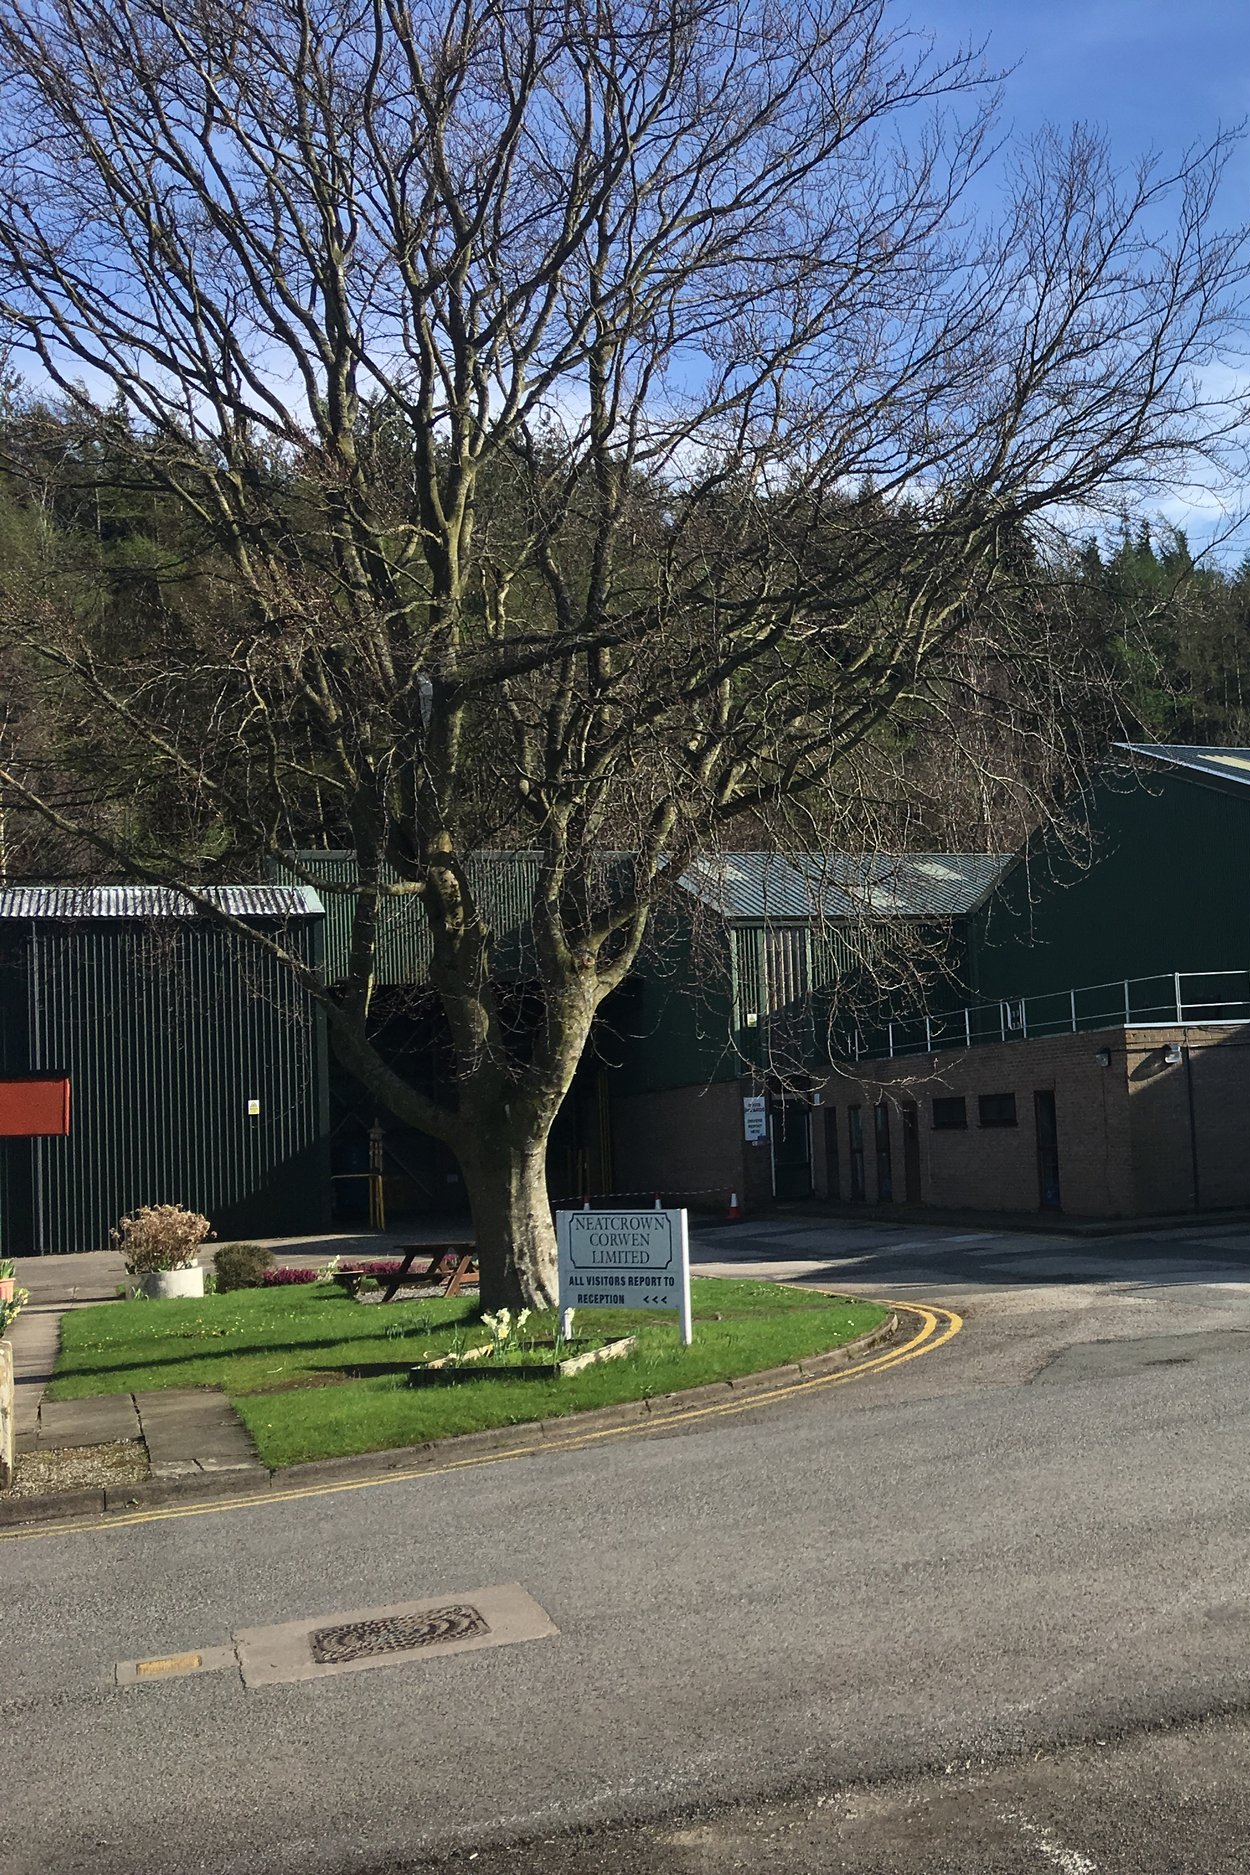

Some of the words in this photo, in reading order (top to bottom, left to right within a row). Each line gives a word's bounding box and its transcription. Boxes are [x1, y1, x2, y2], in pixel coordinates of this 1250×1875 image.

[575, 1216, 665, 1231] NEATCROWN
[589, 1233, 650, 1247] CORWEN
[592, 1250, 650, 1264] LIMITED
[569, 1276, 584, 1286] ALL
[586, 1276, 626, 1287] VISITORS
[628, 1276, 661, 1287] REPORT
[663, 1277, 675, 1287] TO
[577, 1294, 625, 1305] RECEPTION
